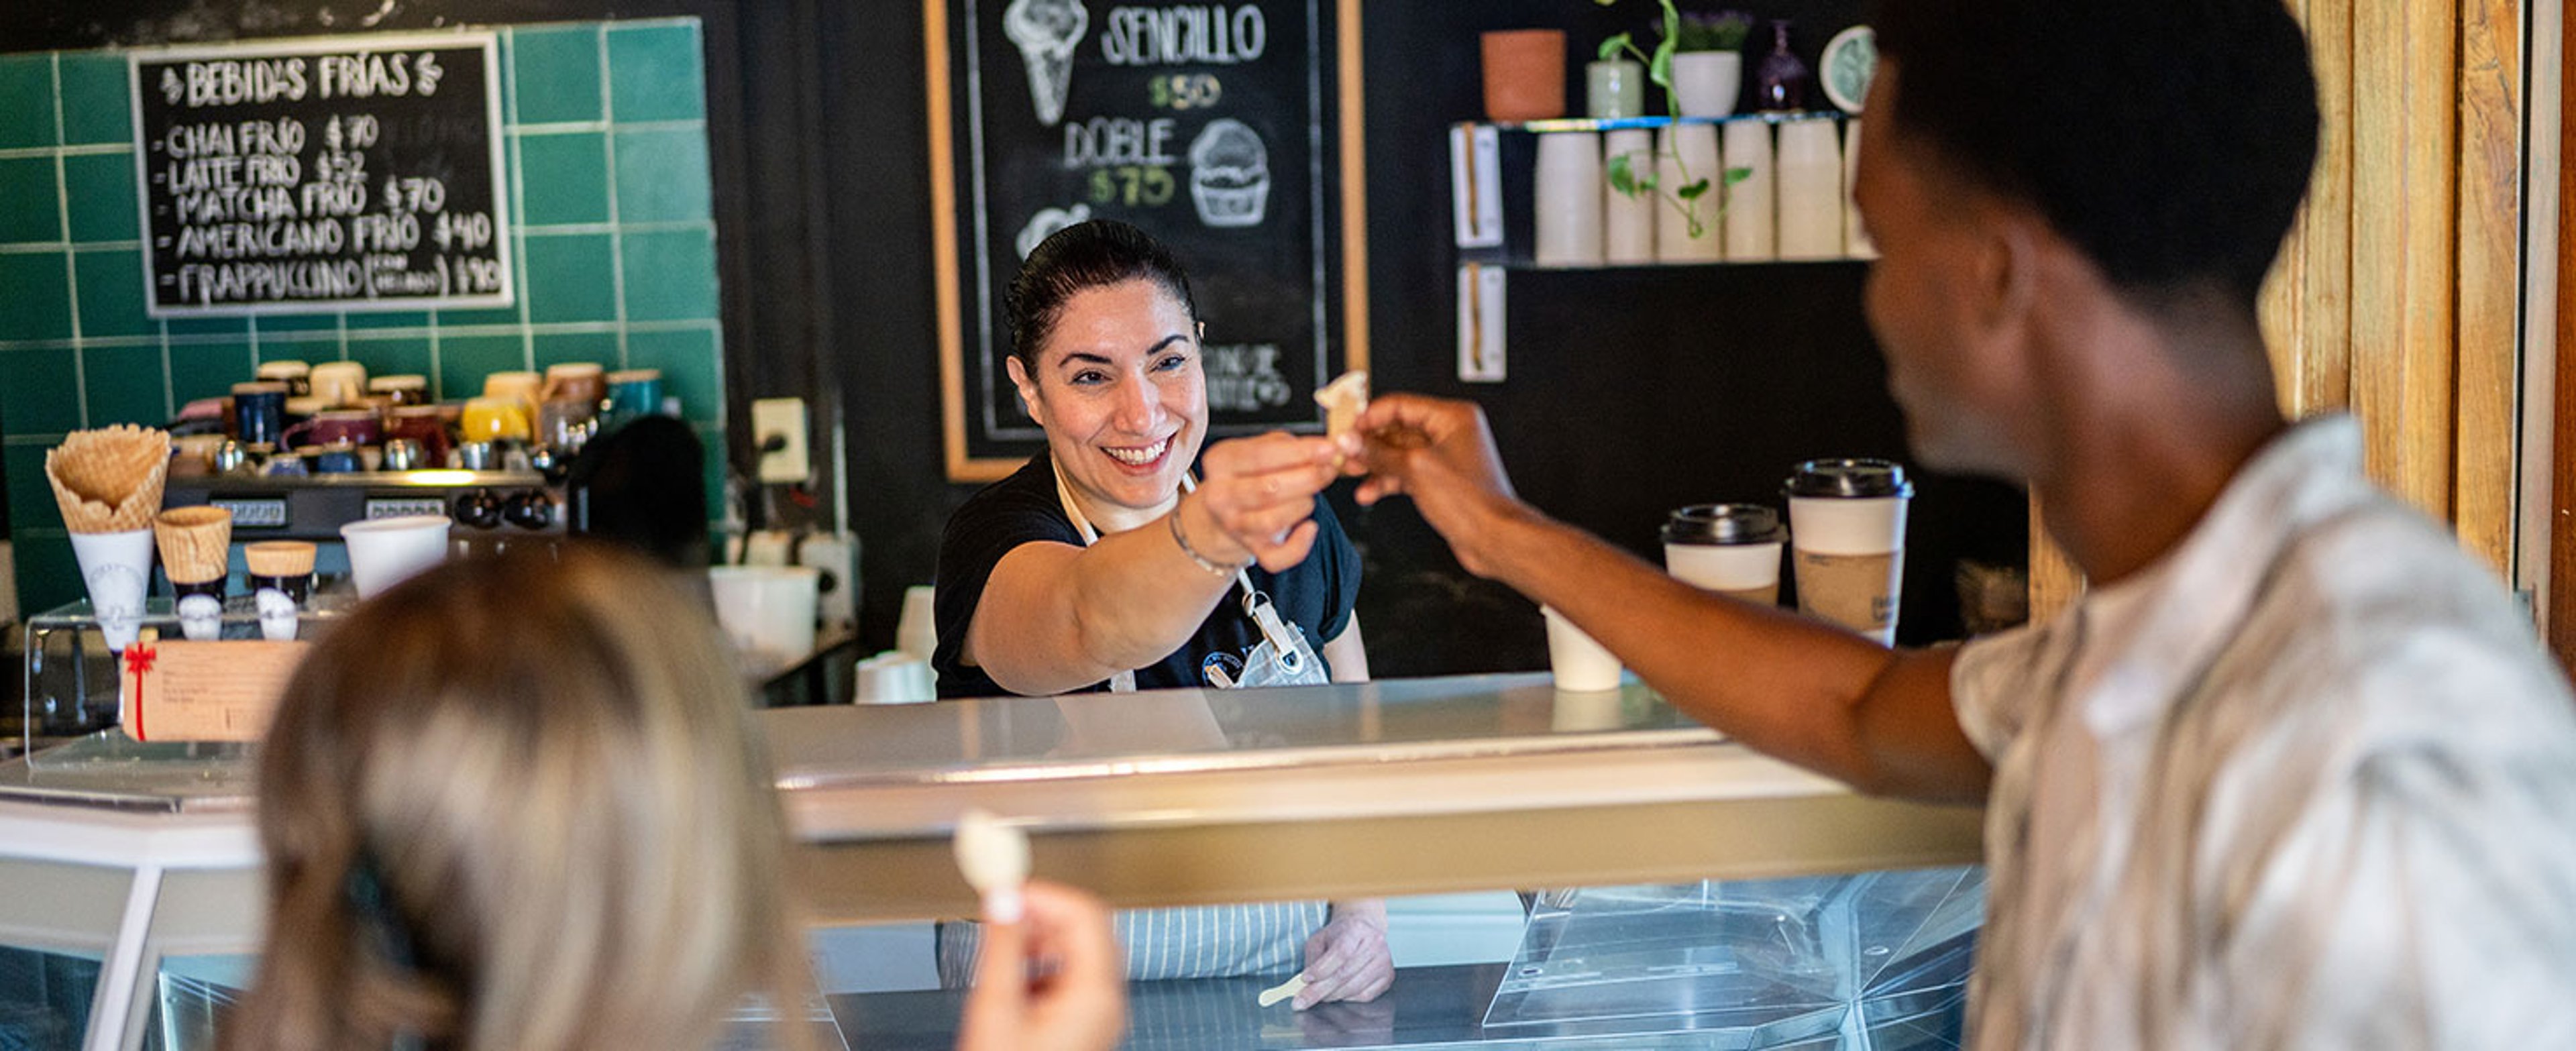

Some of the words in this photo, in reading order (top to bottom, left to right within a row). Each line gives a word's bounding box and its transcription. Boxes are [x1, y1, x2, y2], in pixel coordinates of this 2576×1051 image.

[1101, 4, 1266, 65] SENCILLO
[187, 57, 307, 107] BEBIDAS
[1148, 73, 1222, 111] $50
[167, 123, 234, 158] CHAI
[1063, 115, 1177, 168] DOBLE
[169, 155, 241, 195] LATTE
[1089, 166, 1176, 207] $75
[176, 186, 298, 225] MATCHA
[384, 174, 445, 213] $70
[176, 218, 343, 260] AMERICANO
